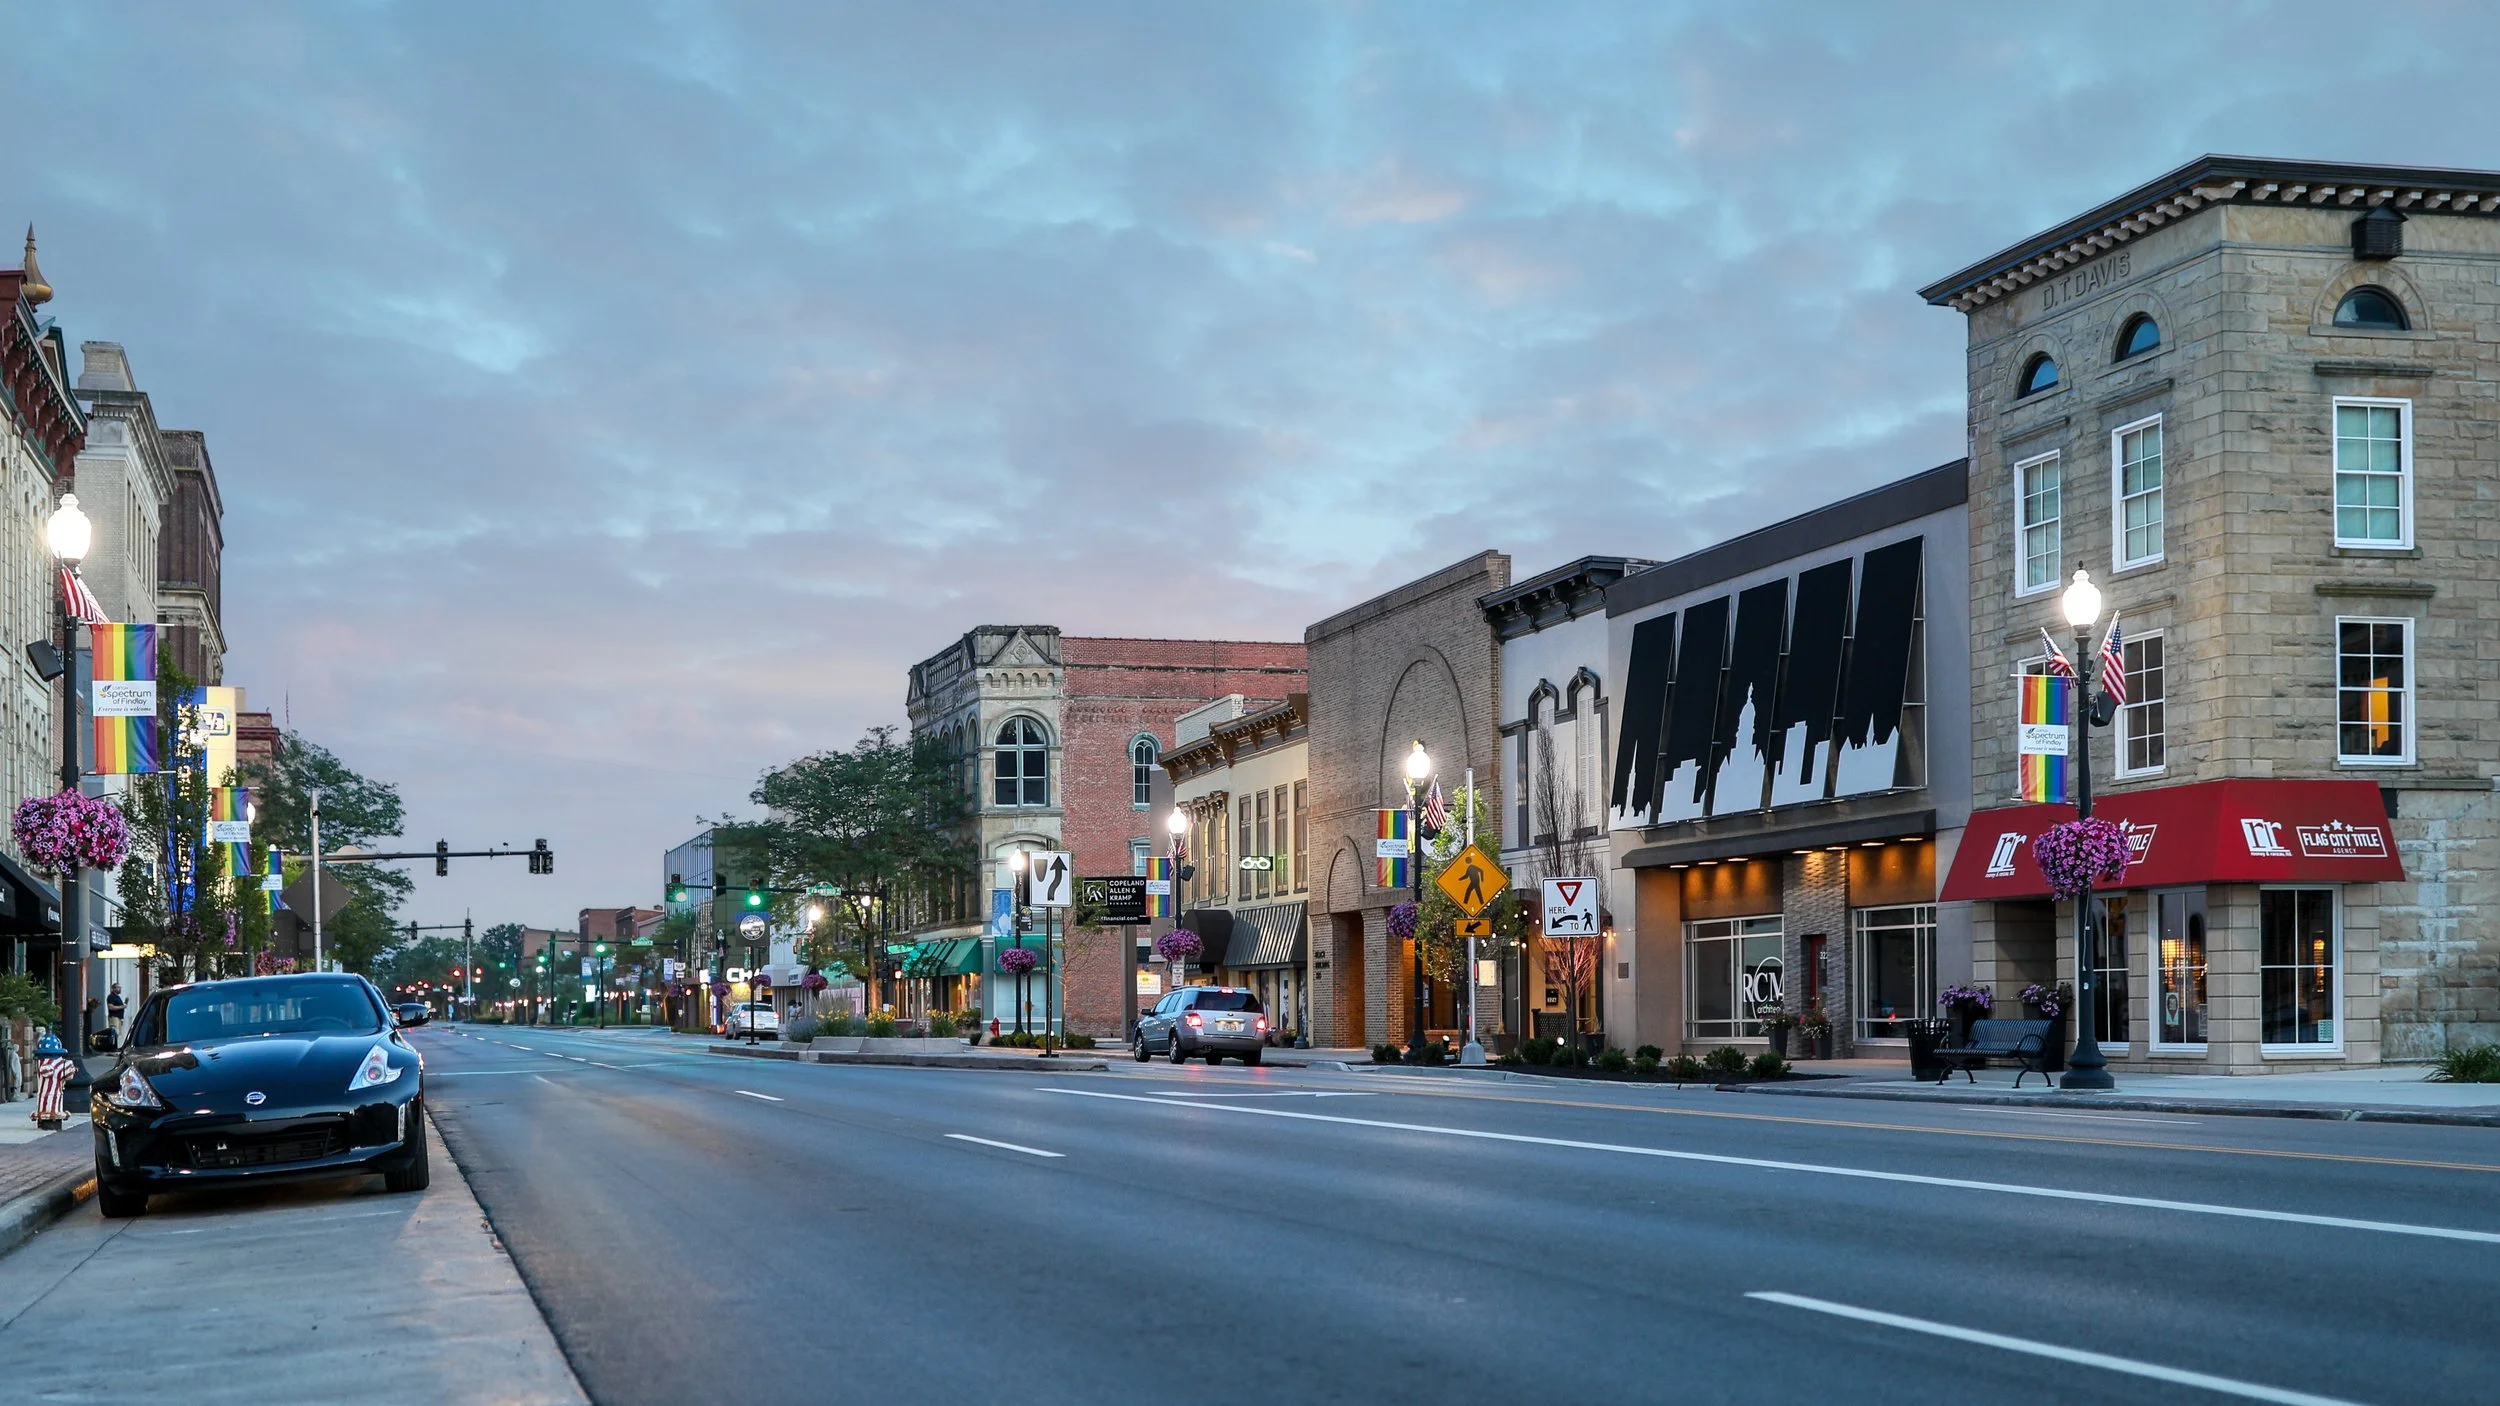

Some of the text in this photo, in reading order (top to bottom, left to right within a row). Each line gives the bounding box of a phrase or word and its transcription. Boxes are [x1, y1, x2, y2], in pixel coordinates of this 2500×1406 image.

[2074, 252, 2131, 297] DAVIS
[107, 690, 152, 699] spectrum
[121, 698, 147, 706] Findlay
[2031, 732, 2066, 740] spectrum
[2127, 833, 2150, 851] TITLE
[2302, 833, 2380, 847] FLAG CITY TITLE
[1548, 906, 1567, 914] HERE
[1570, 922, 1579, 930] TO
[1743, 971, 1784, 1003] RCM
